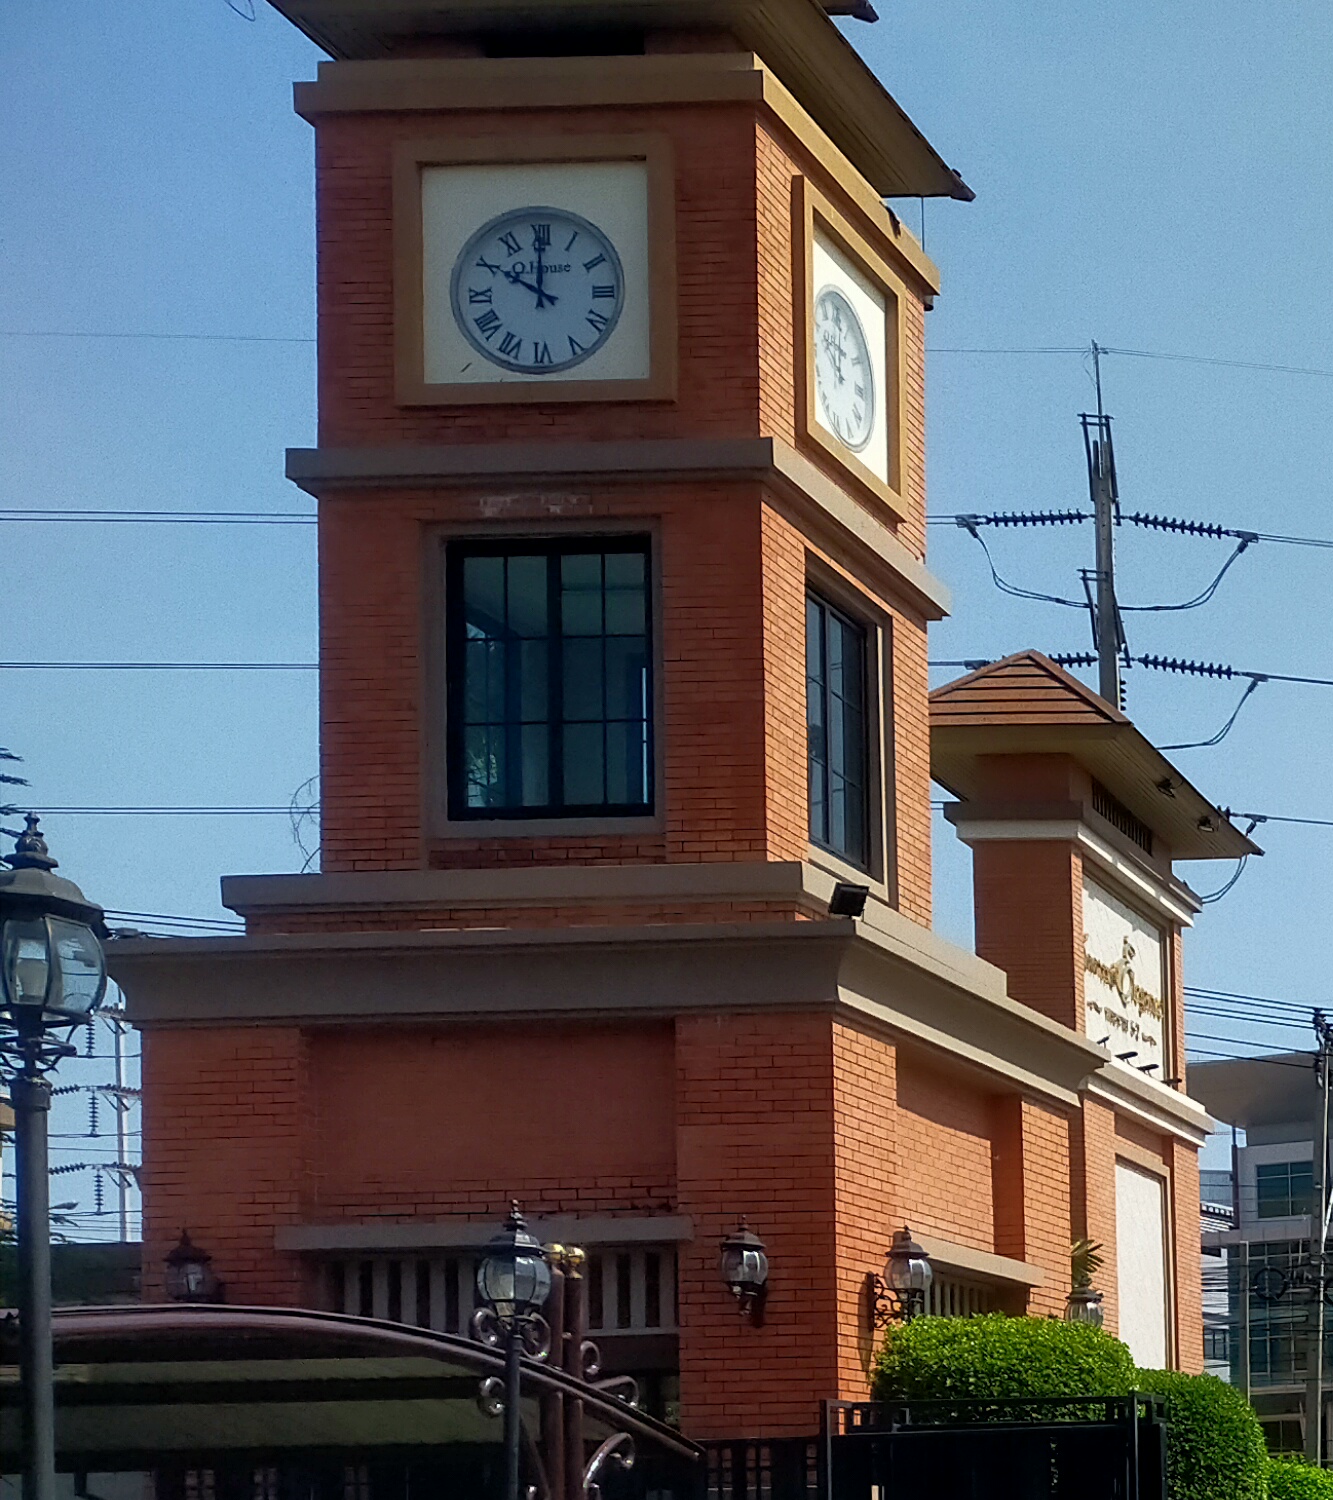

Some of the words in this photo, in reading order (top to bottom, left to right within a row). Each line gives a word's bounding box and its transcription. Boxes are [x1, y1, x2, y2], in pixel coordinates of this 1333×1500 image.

[498, 231, 522, 257] XI
[565, 231, 578, 251] I
[476, 256, 500, 277] X
[583, 253, 607, 273] II
[469, 286, 492, 304] IX
[592, 285, 615, 299] III
[473, 308, 502, 341] VIII
[586, 309, 609, 334] IV
[497, 332, 522, 361] VII
[533, 341, 553, 364] VI
[568, 335, 589, 356] V
